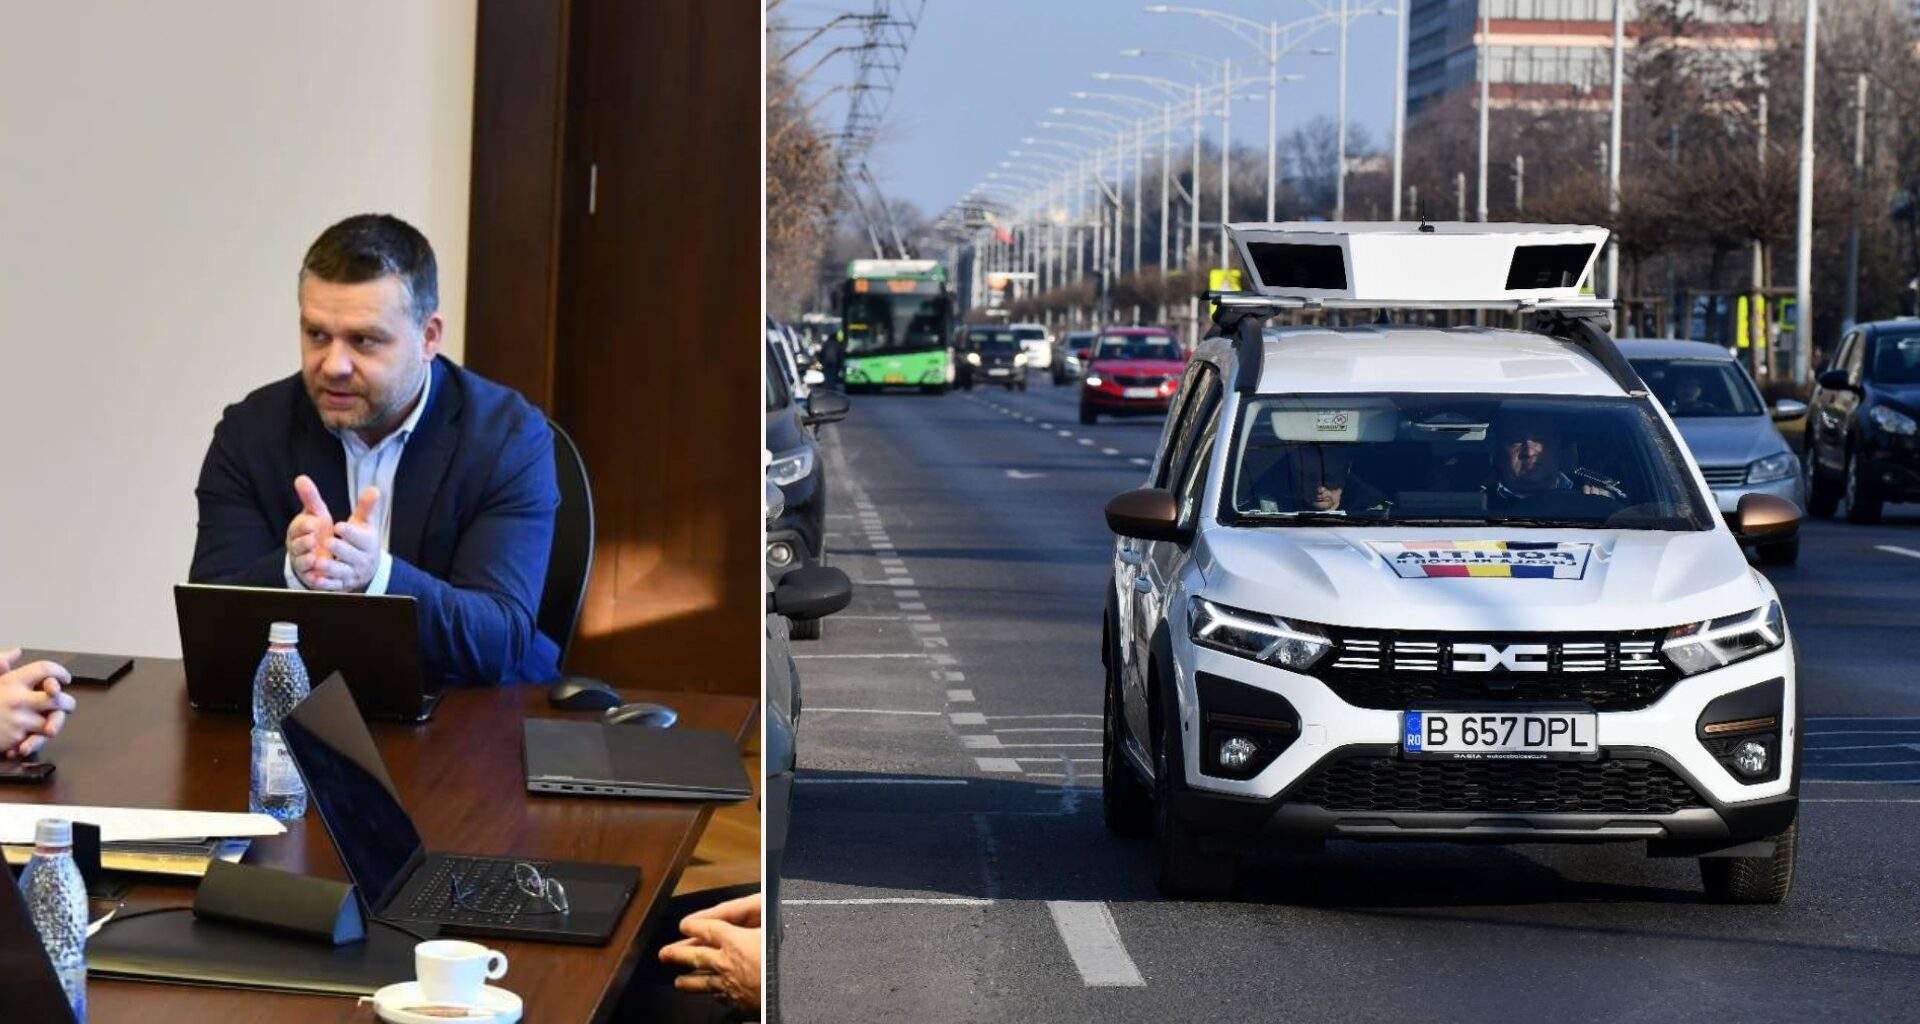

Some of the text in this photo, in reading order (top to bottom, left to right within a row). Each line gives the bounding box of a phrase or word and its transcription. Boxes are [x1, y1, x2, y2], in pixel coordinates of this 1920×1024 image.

[1407, 734, 1421, 746] RO
[1427, 716, 1588, 747] B 657 DPL
